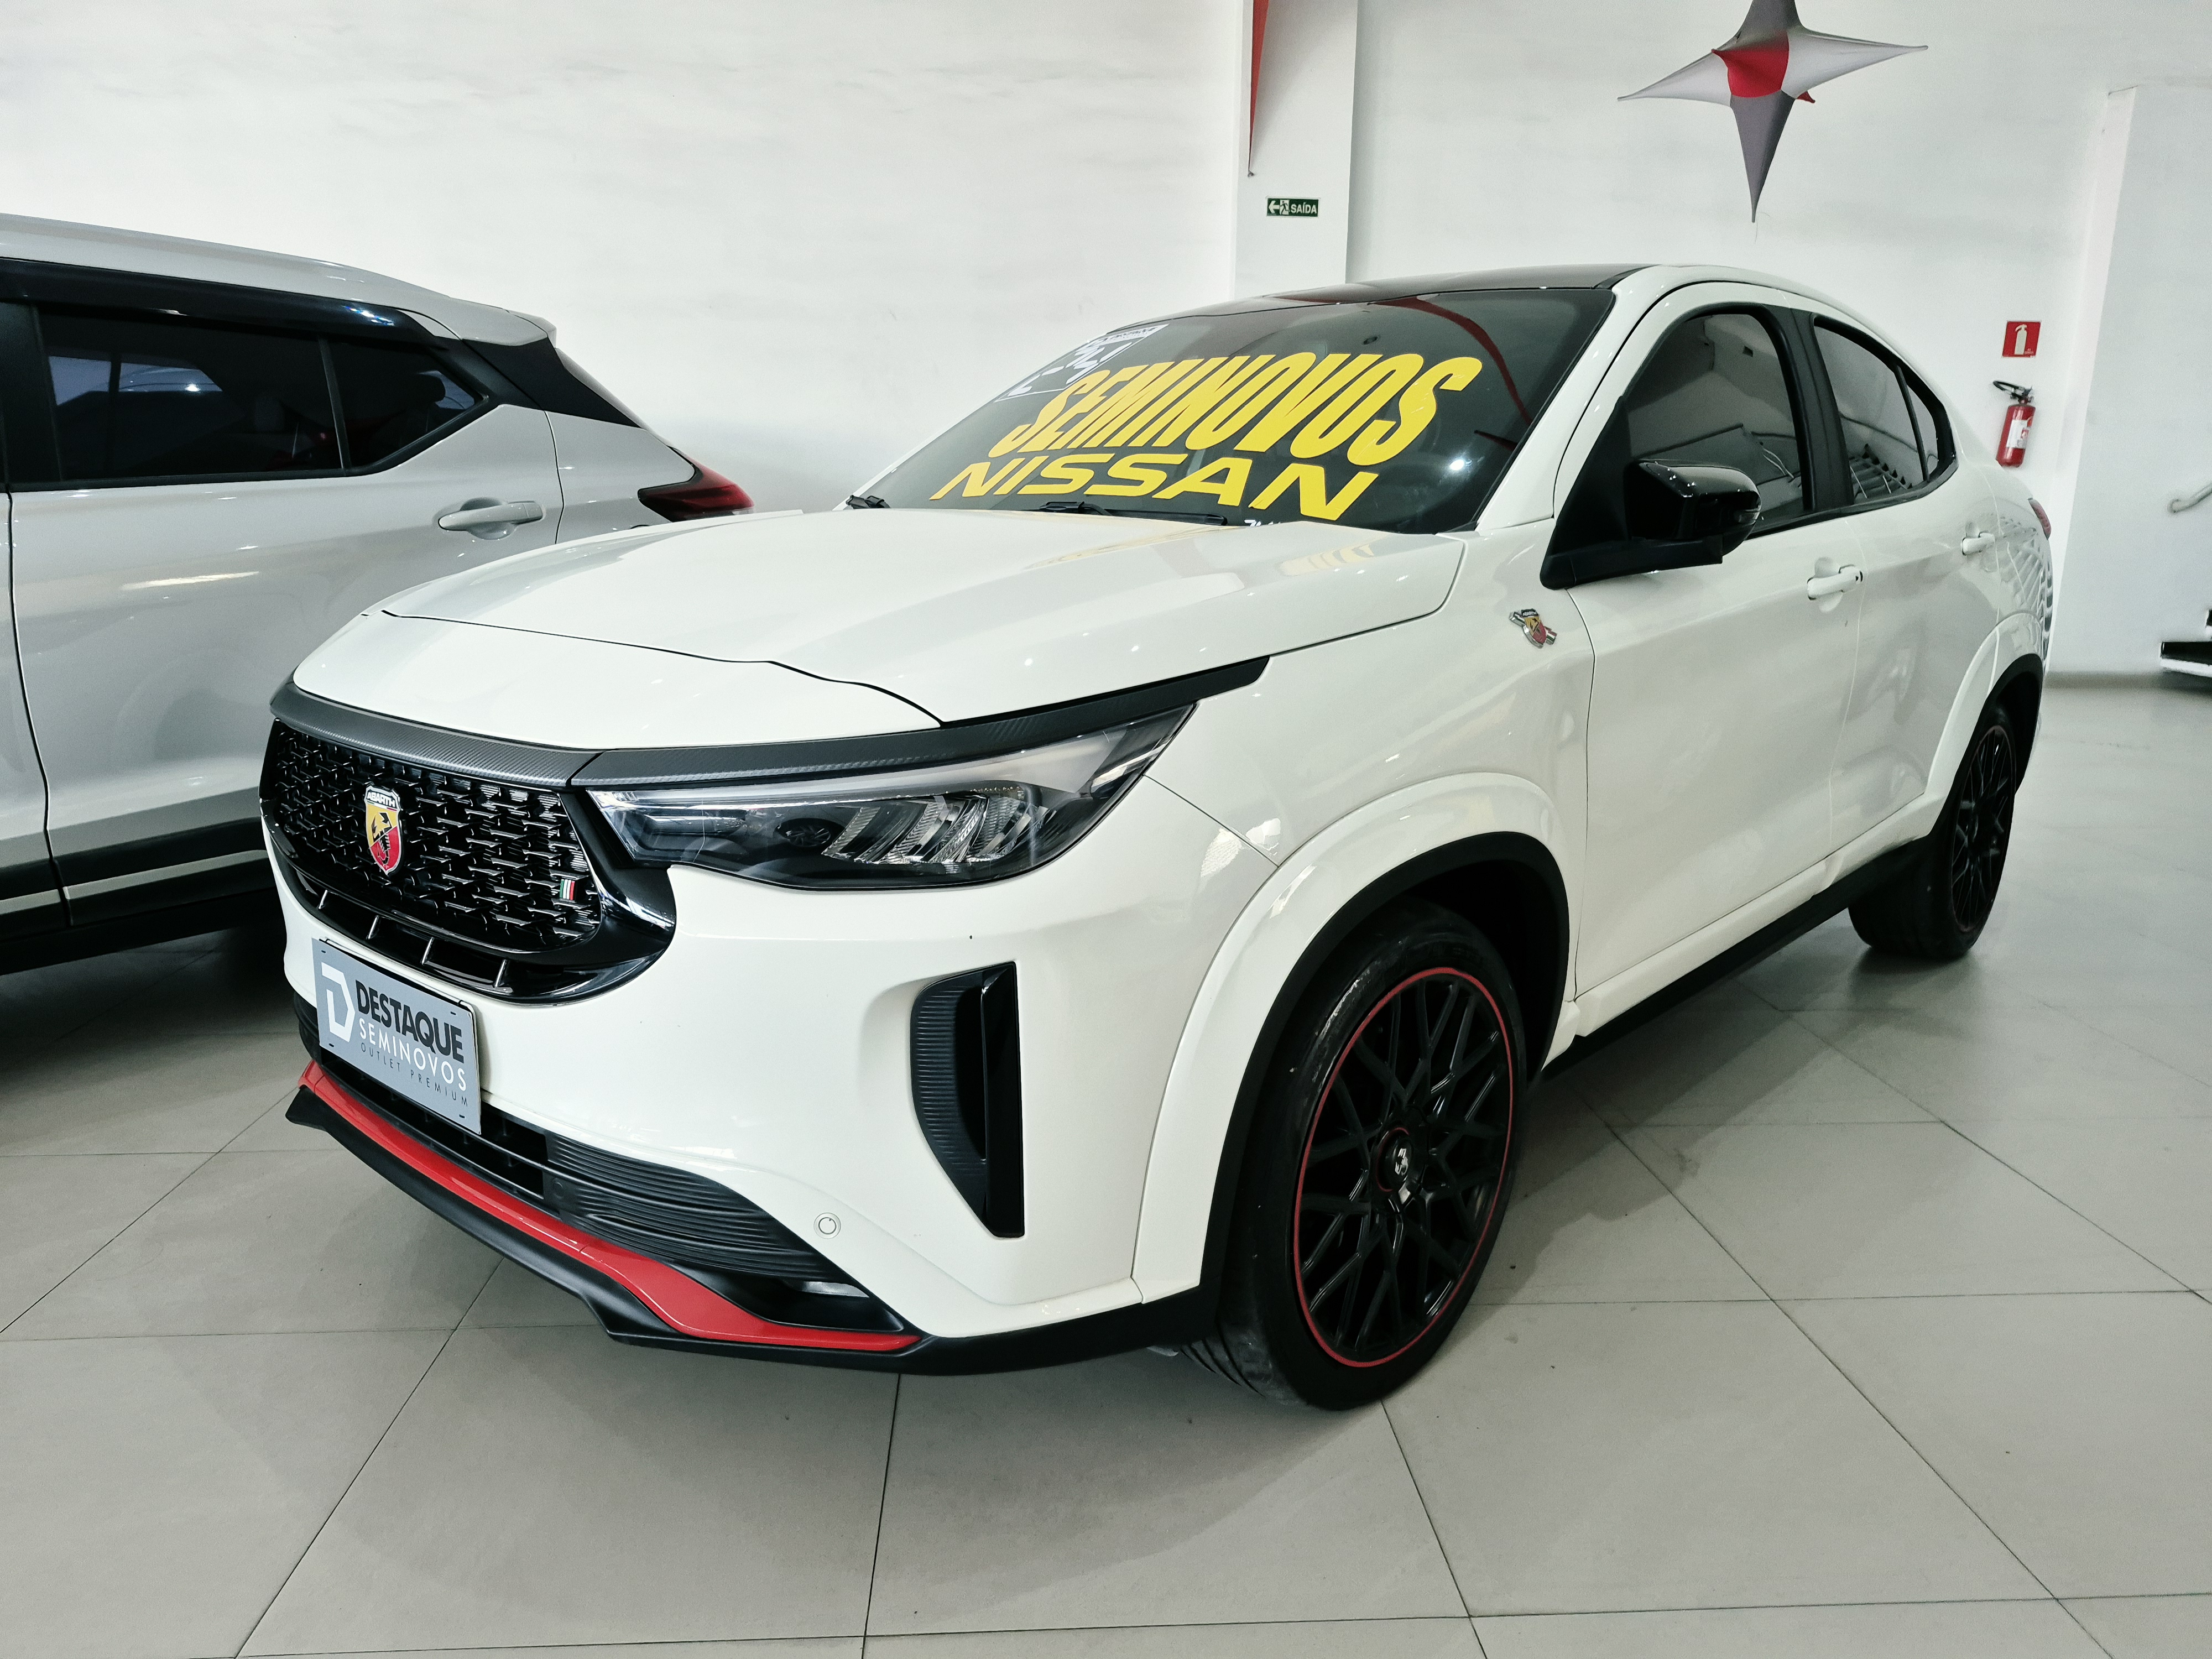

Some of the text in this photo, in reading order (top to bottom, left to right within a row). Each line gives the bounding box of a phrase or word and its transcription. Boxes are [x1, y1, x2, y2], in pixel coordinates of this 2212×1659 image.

[1290, 202, 1317, 214] SAÍDA
[989, 352, 1483, 466] SEMINOVOS
[930, 453, 1379, 521] NISSAN
[367, 791, 395, 807] ABARTH
[356, 980, 465, 1064] DESTAQUE
[359, 1017, 466, 1092] SEMINOVOS
[361, 1042, 468, 1107] OUTLET PREMIUM
